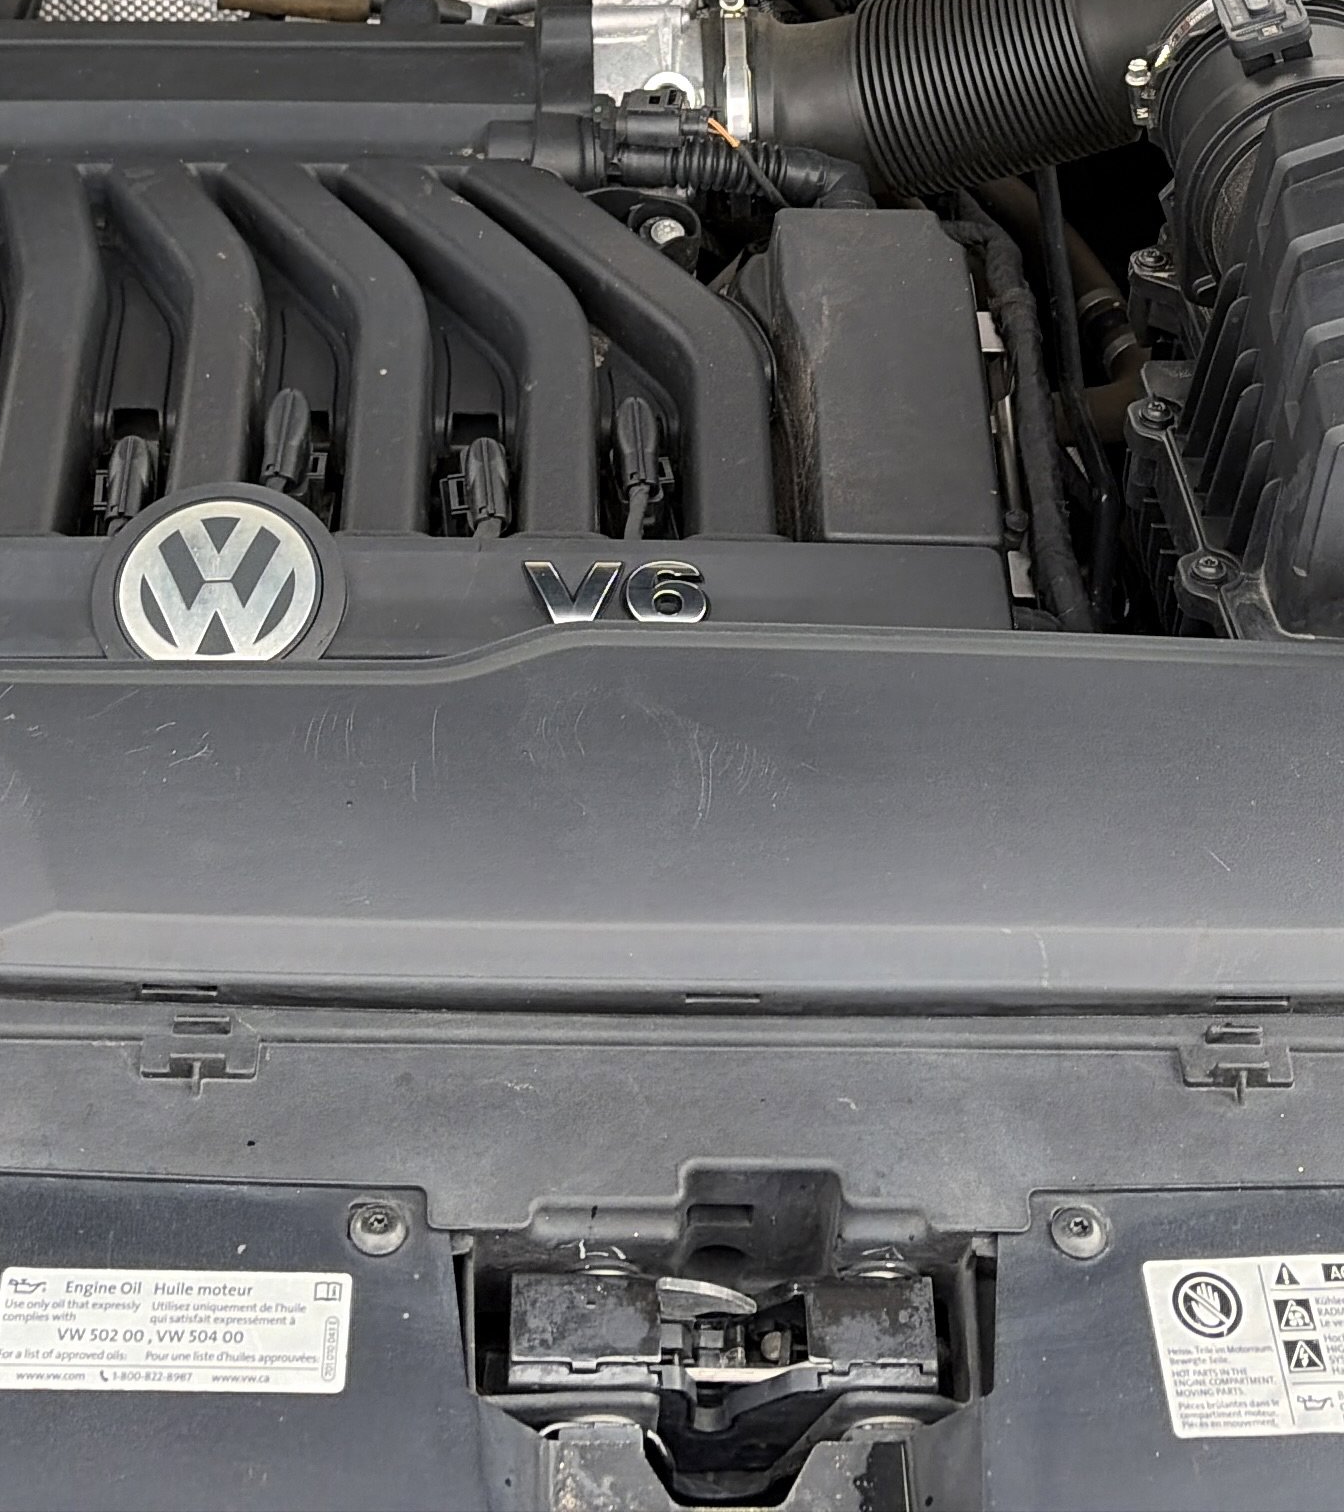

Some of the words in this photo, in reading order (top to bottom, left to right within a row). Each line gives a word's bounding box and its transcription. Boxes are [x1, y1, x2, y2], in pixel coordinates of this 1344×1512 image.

[119, 501, 317, 661] VW
[524, 560, 709, 623] V6
[65, 1280, 116, 1298] Engine
[120, 1281, 142, 1295] Oil
[154, 1282, 194, 1295] Huile
[197, 1284, 254, 1297] moteur
[4, 1299, 24, 1309] Use
[27, 1299, 50, 1311] only
[51, 1300, 65, 1309] oil
[67, 1300, 89, 1310] that
[92, 1301, 141, 1313] expressly
[152, 1301, 190, 1312] Utilisez
[192, 1303, 258, 1314] uniquement
[259, 1303, 273, 1313] de
[274, 1303, 307, 1314] l'huile
[2, 1312, 50, 1325] complies
[52, 1312, 76, 1321] with
[150, 1314, 167, 1324] qui
[169, 1314, 211, 1324] satisfait
[213, 1315, 286, 1327] expressément
[289, 1316, 296, 1326] à
[57, 1327, 86, 1341] VW
[90, 1328, 118, 1342] 502
[122, 1329, 144, 1342] 00
[156, 1330, 185, 1343] VW
[188, 1330, 217, 1343] 504
[222, 1331, 244, 1343] 00
[15, 1351, 22, 1359] a
[24, 1349, 39, 1359] list
[42, 1349, 54, 1359] of
[55, 1350, 105, 1361] approved
[106, 1350, 127, 1361] oils:
[145, 1351, 170, 1361] Pour
[175, 1353, 192, 1361] une
[193, 1351, 214, 1362] liste
[216, 1352, 256, 1363] d'huiles
[16, 1371, 85, 1380] www.vw.com
[211, 1373, 270, 1383] www.vw.ca
